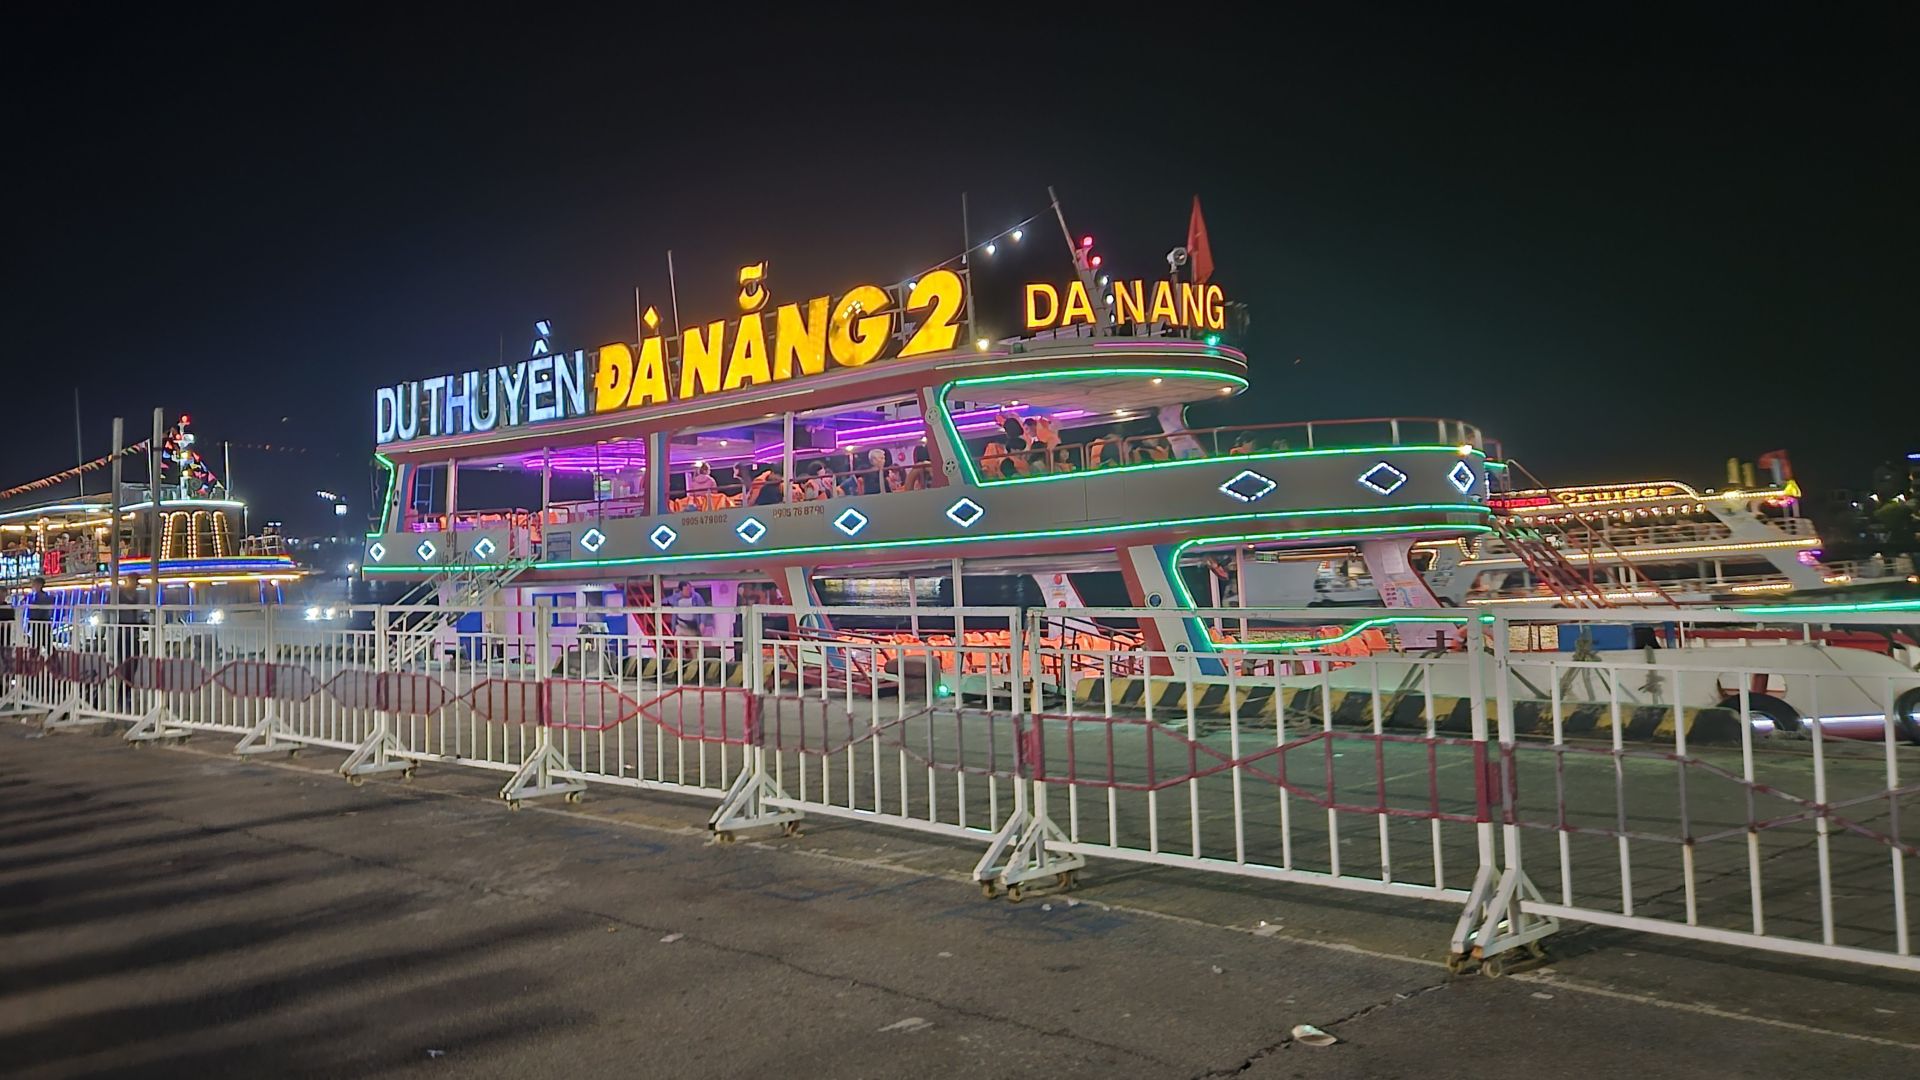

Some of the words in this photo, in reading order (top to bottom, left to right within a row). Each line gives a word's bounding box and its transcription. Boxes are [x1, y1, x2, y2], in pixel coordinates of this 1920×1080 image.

[376, 381, 418, 444] DU
[423, 320, 586, 436] THUYỀN
[678, 261, 893, 399] NẴNG
[897, 267, 965, 359] 2
[1025, 280, 1097, 329] DA
[1113, 279, 1226, 330] NANG
